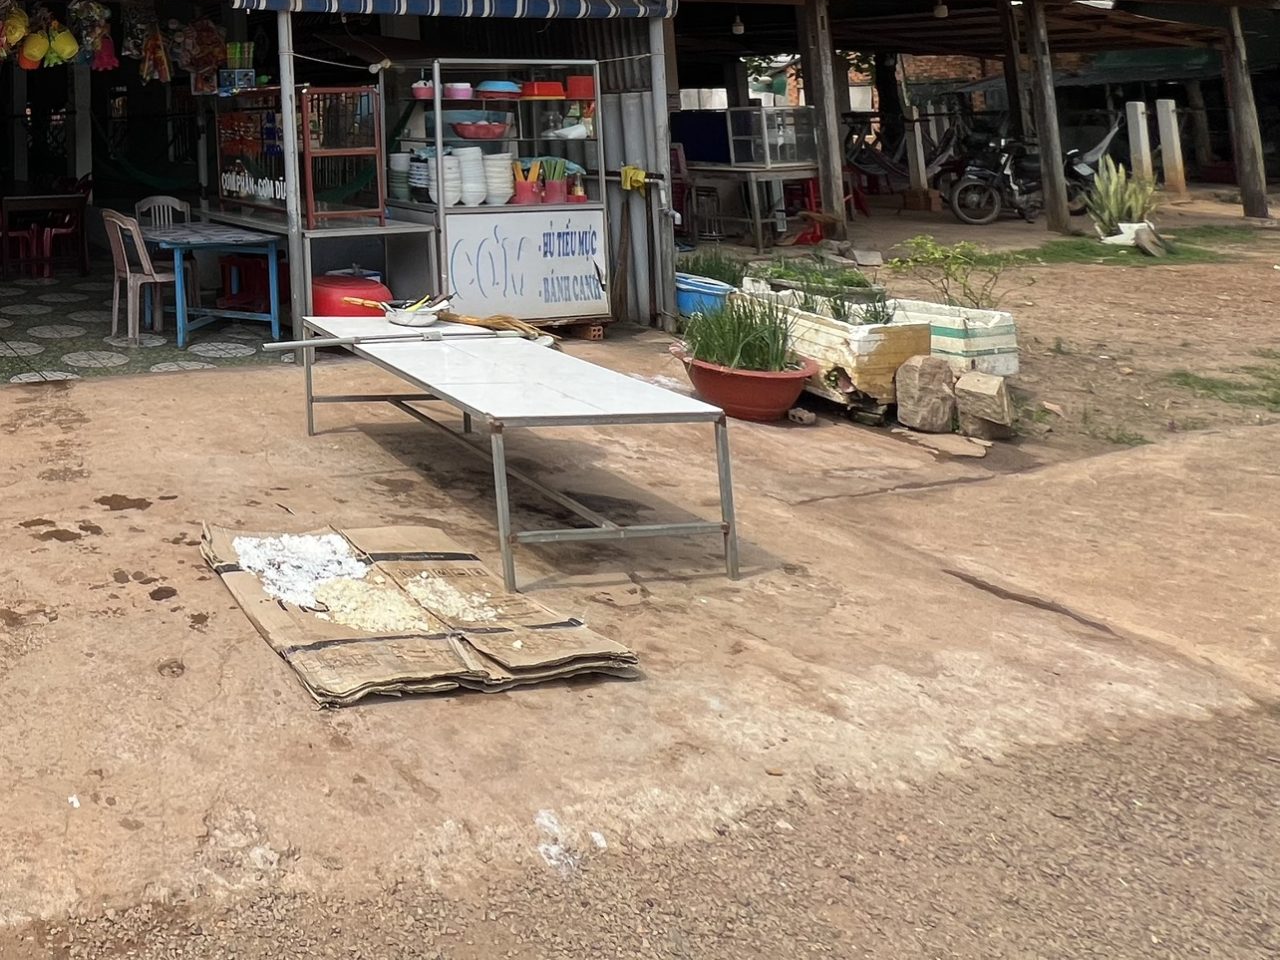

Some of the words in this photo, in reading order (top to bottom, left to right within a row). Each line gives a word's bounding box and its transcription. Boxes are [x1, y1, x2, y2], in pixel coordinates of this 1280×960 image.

[556, 217, 577, 258] TIẾU
[542, 268, 572, 304] BÁNH
[572, 274, 602, 302] CANH
